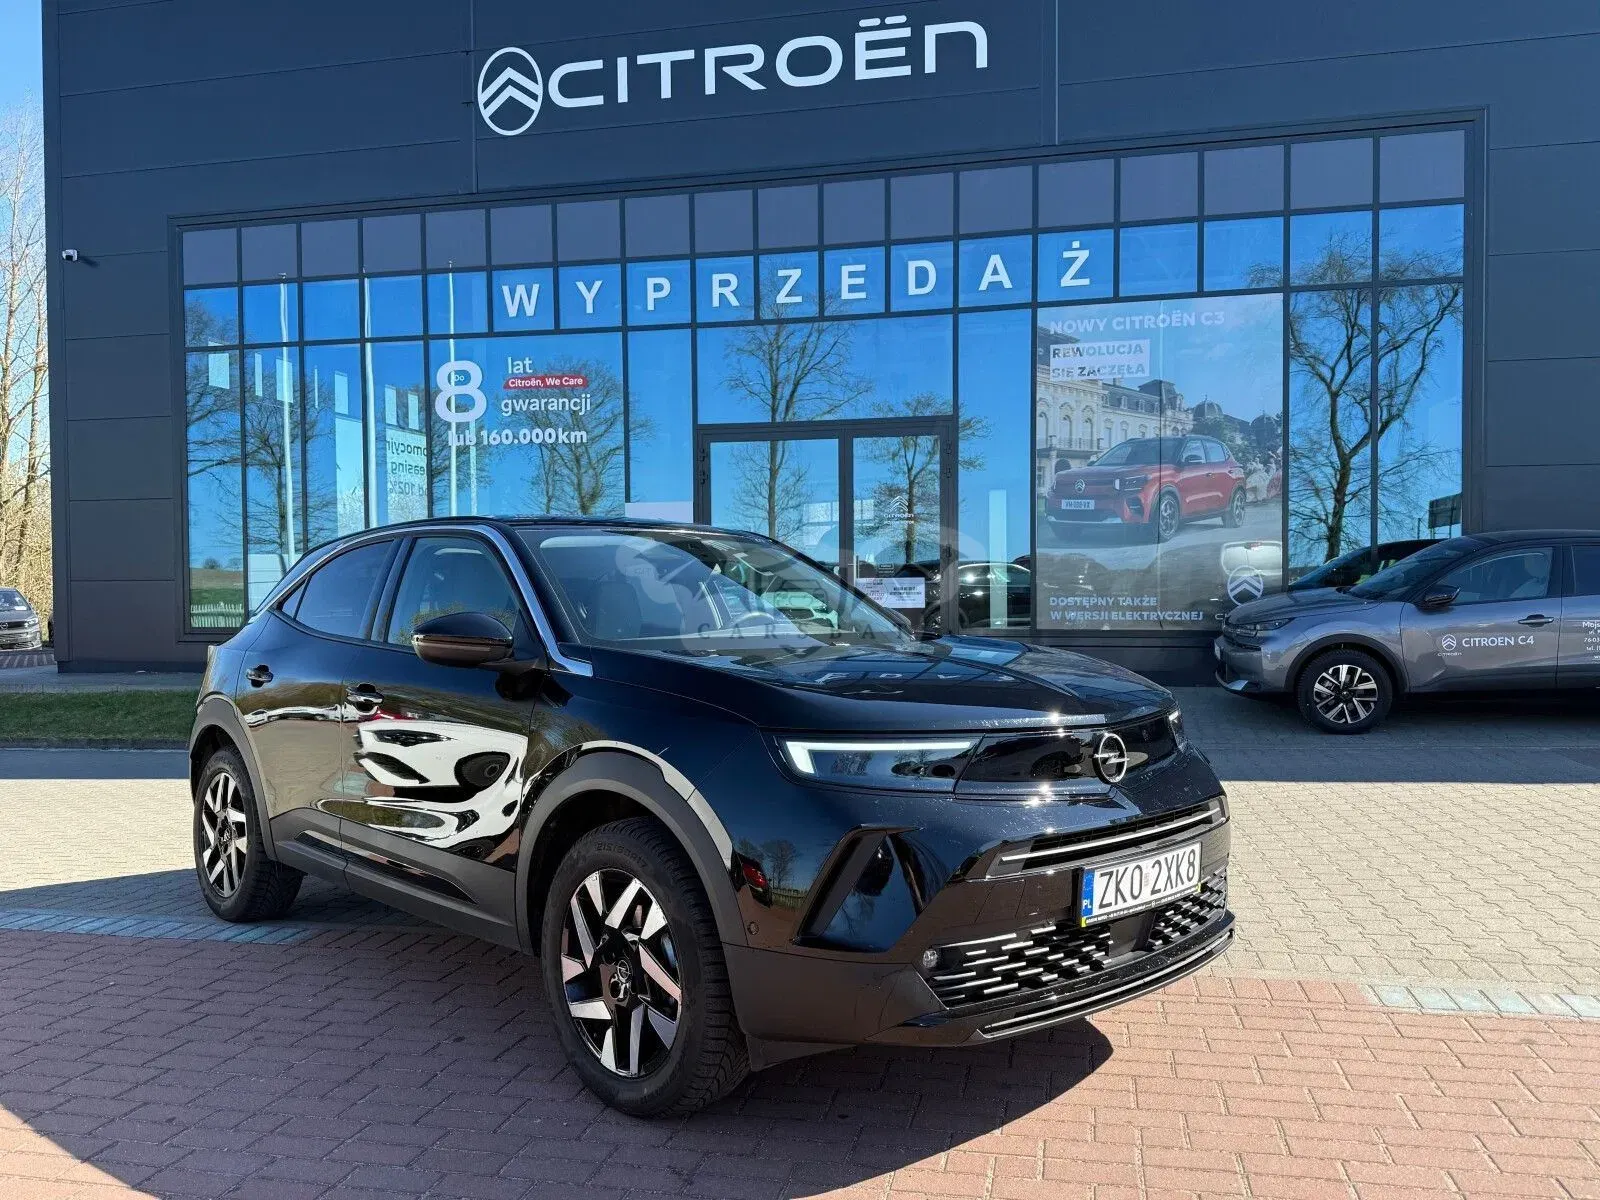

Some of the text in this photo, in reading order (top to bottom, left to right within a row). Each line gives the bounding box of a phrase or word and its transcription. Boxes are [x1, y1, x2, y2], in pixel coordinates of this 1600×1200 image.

[548, 15, 988, 108] CITROËN
[1050, 310, 1225, 334] NOWY CITROËN C3
[1052, 343, 1144, 359] REWOLUCJA
[507, 356, 533, 374] lat
[508, 376, 583, 388] Citroën, We Care
[435, 360, 487, 423] 8
[501, 393, 591, 417] gwarancji
[448, 429, 477, 446] lub
[1050, 594, 1157, 608] DOSTĘPNY TAKŻE
[1051, 611, 1203, 621] W WERSJI ELEKTRYCZNEJ
[1518, 635, 1535, 645] C4
[1150, 848, 1196, 896] 2XK8
[1083, 899, 1092, 909] PL
